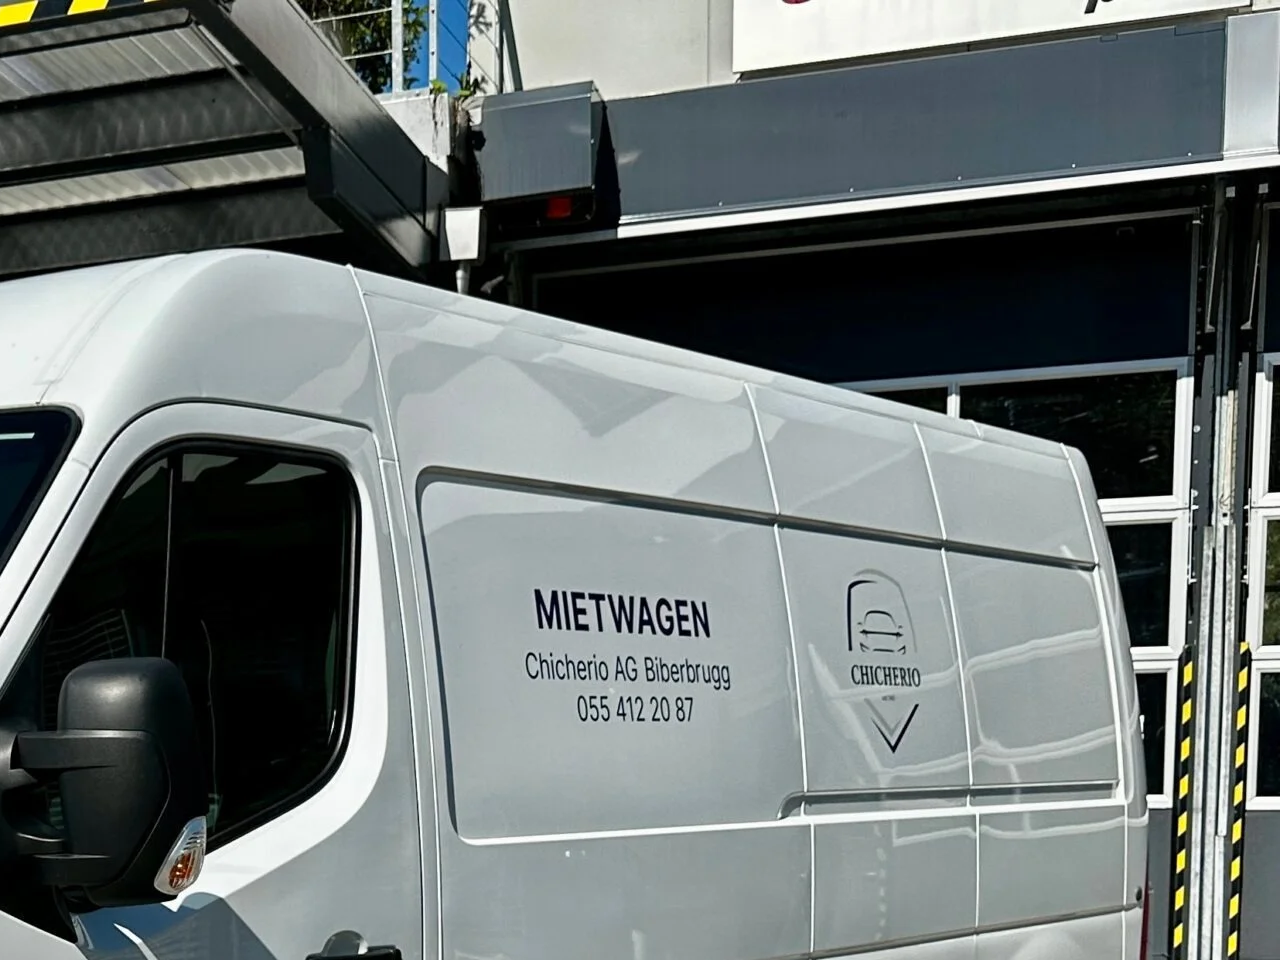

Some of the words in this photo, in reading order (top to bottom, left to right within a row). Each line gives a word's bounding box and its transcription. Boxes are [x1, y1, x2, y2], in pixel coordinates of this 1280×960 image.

[533, 588, 711, 639] MIETWAGEN
[524, 651, 609, 681] Chicherio
[614, 655, 638, 682] AG
[643, 656, 731, 691] Biberbrugg
[850, 664, 921, 688] CHICHERIO
[576, 695, 611, 722] 055
[616, 695, 646, 722] 412
[650, 695, 671, 722] 20
[675, 696, 694, 722] 87
